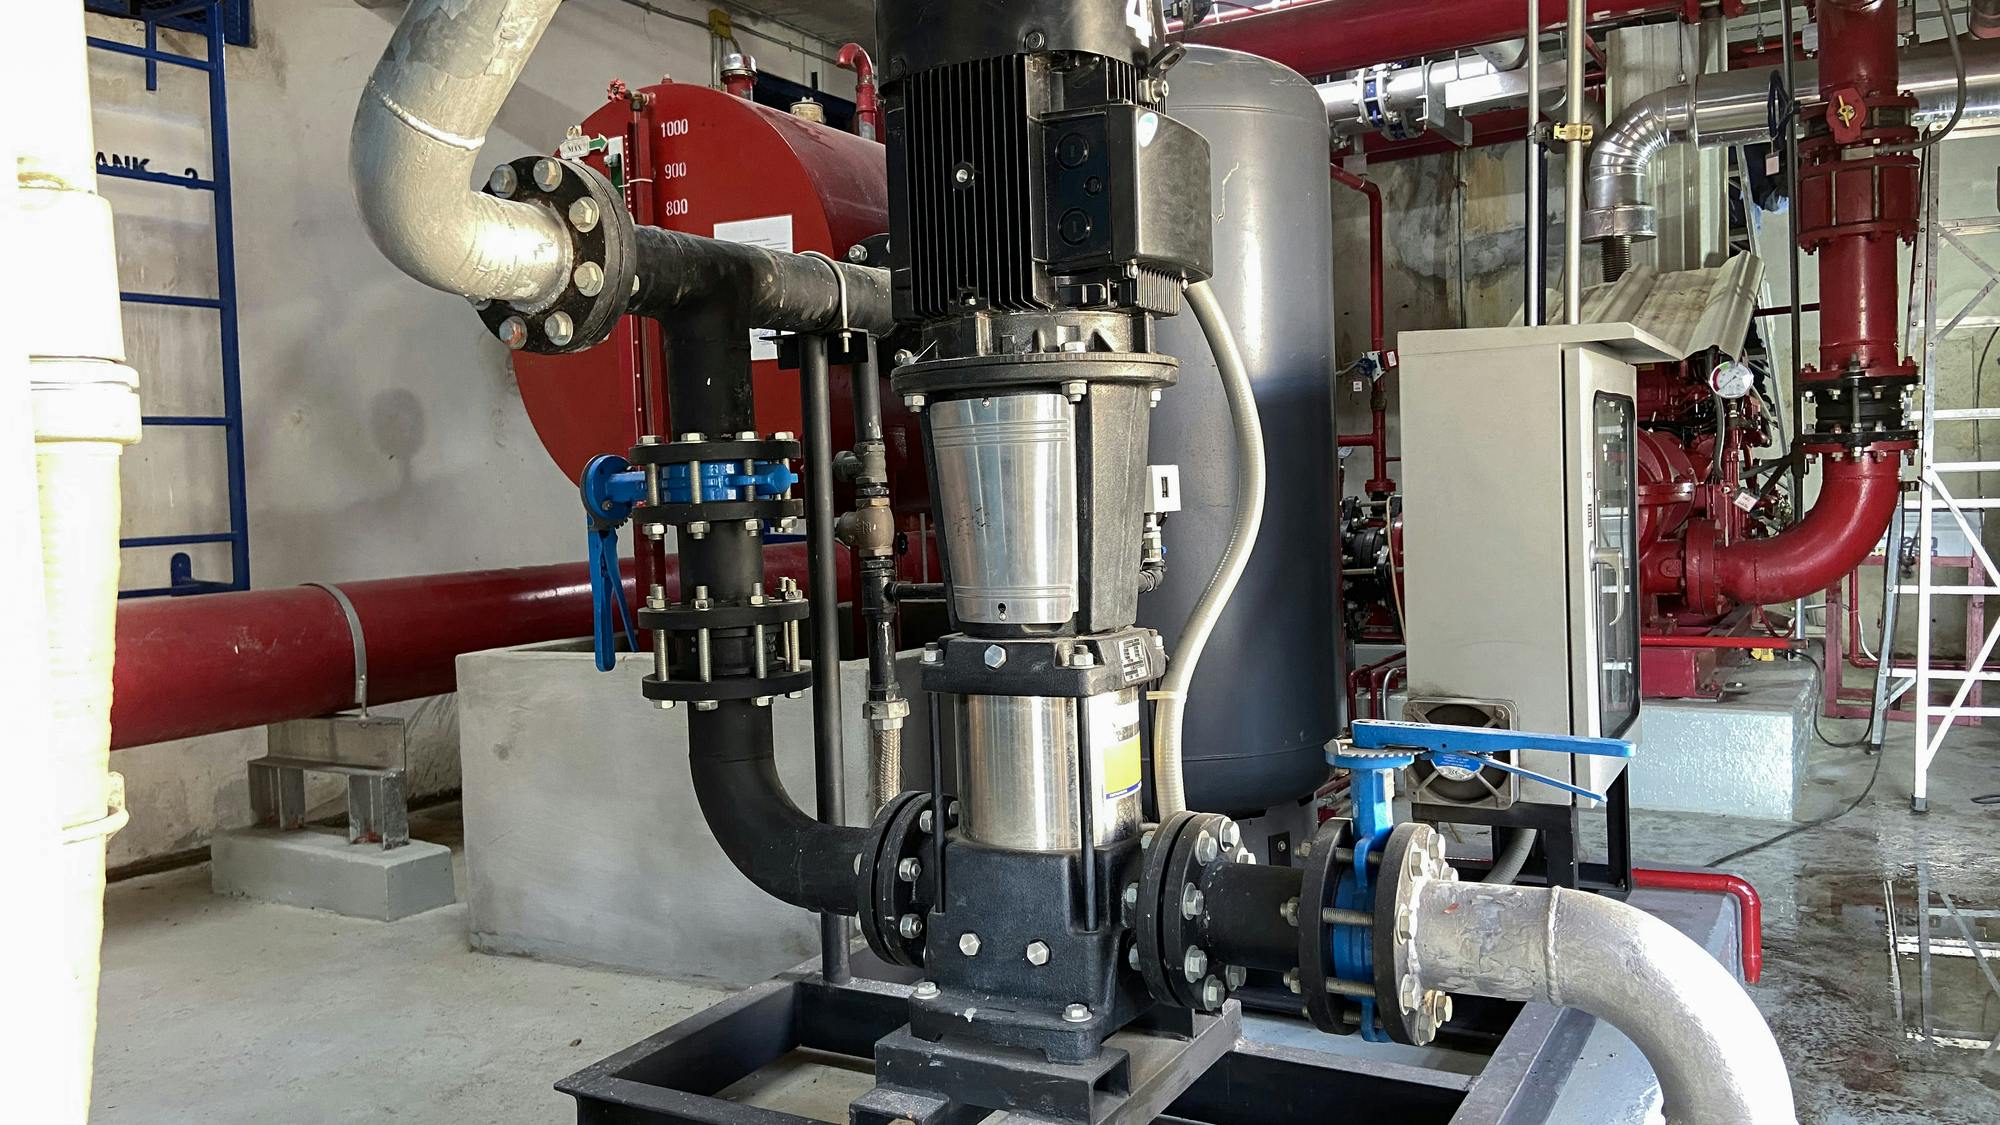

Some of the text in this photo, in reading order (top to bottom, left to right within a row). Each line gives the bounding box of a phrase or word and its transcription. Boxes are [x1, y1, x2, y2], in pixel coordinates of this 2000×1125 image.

[660, 118, 689, 138] 1000
[95, 151, 150, 174] ANK
[664, 161, 687, 180] 900
[665, 198, 689, 216] 800
